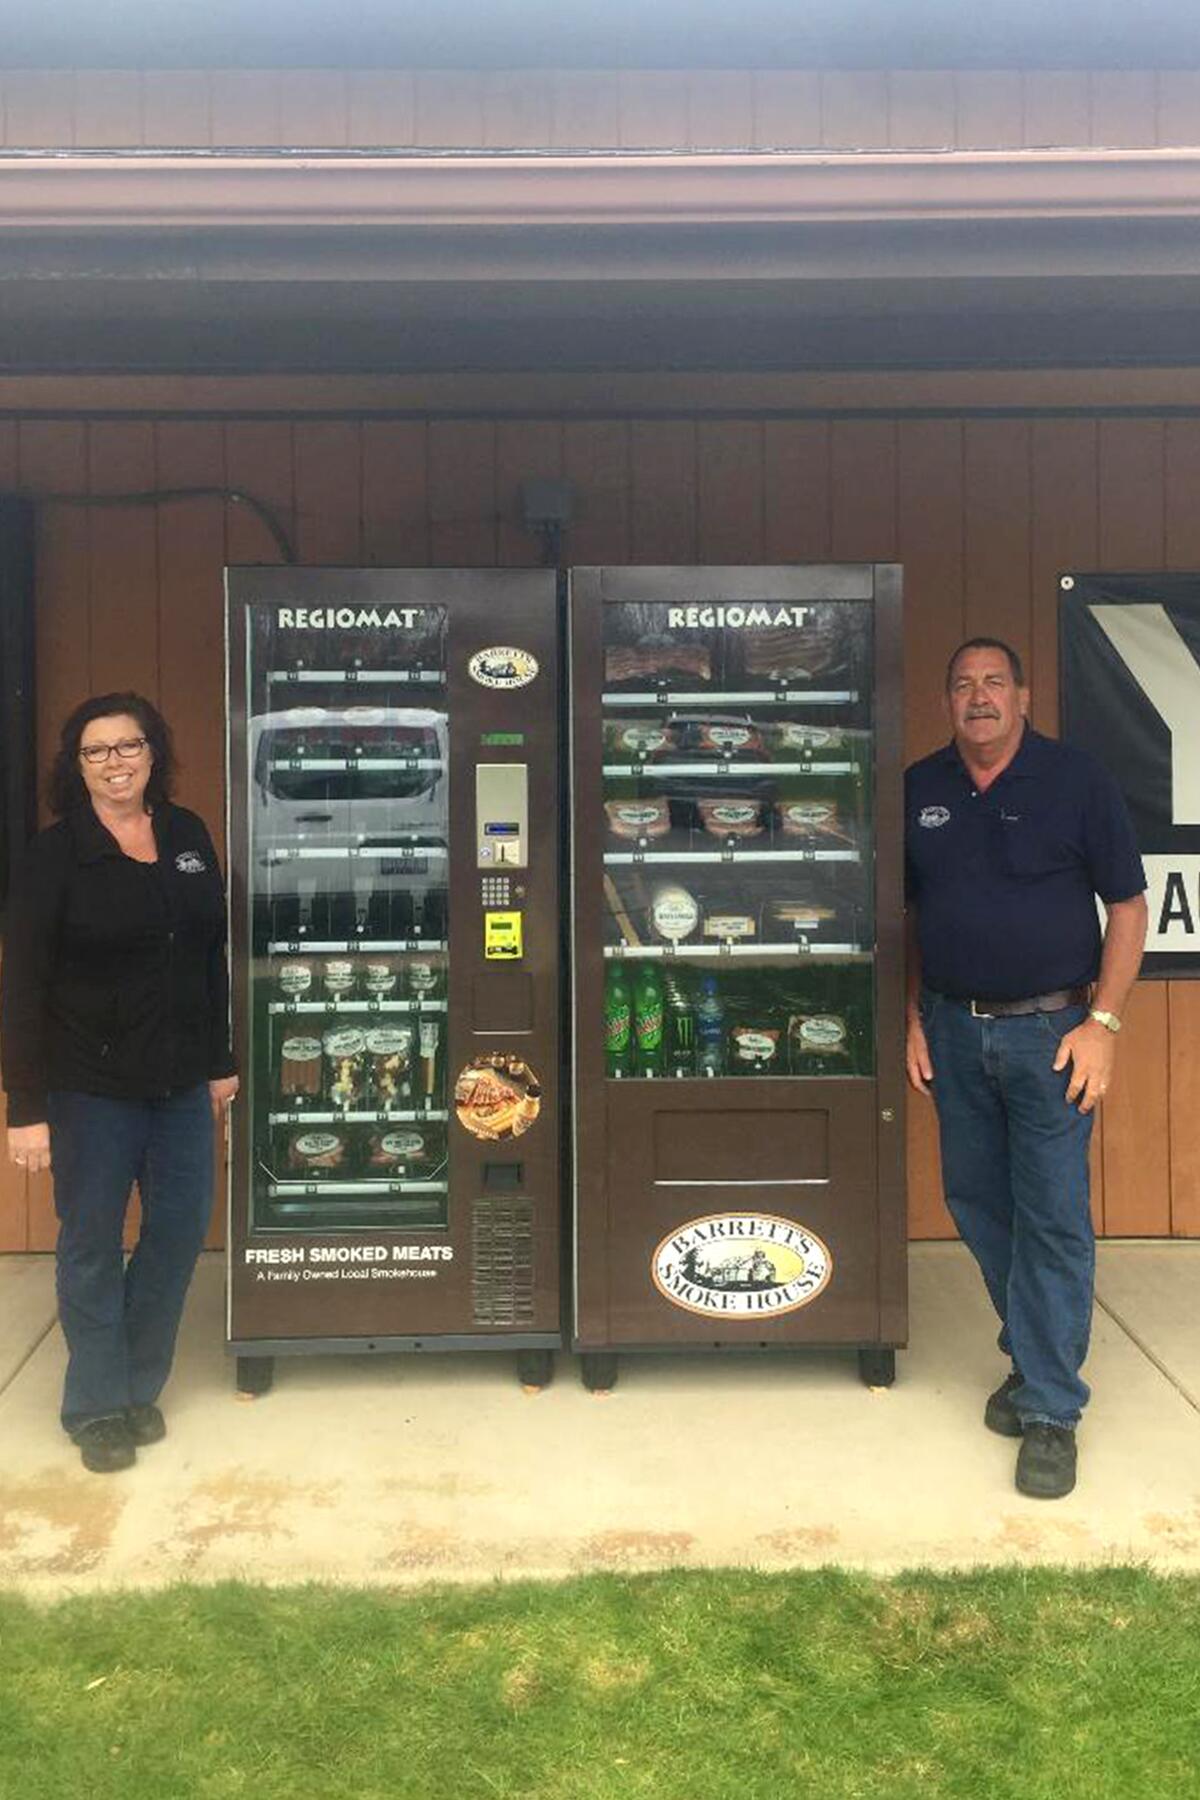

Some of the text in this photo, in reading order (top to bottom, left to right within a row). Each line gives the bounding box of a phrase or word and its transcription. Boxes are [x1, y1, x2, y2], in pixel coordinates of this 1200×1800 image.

[279, 608, 418, 629] REGIOMAT
[668, 606, 809, 628] REGIOMAT
[1158, 872, 1200, 934] A
[245, 1245, 454, 1264] FRESH SMOKED MEATS
[256, 1270, 266, 1281] A
[302, 1269, 339, 1280] Owned
[341, 1268, 369, 1279] Local
[370, 1267, 438, 1279] Smokehouse
[659, 1260, 825, 1310] SMOKE HOUSE
